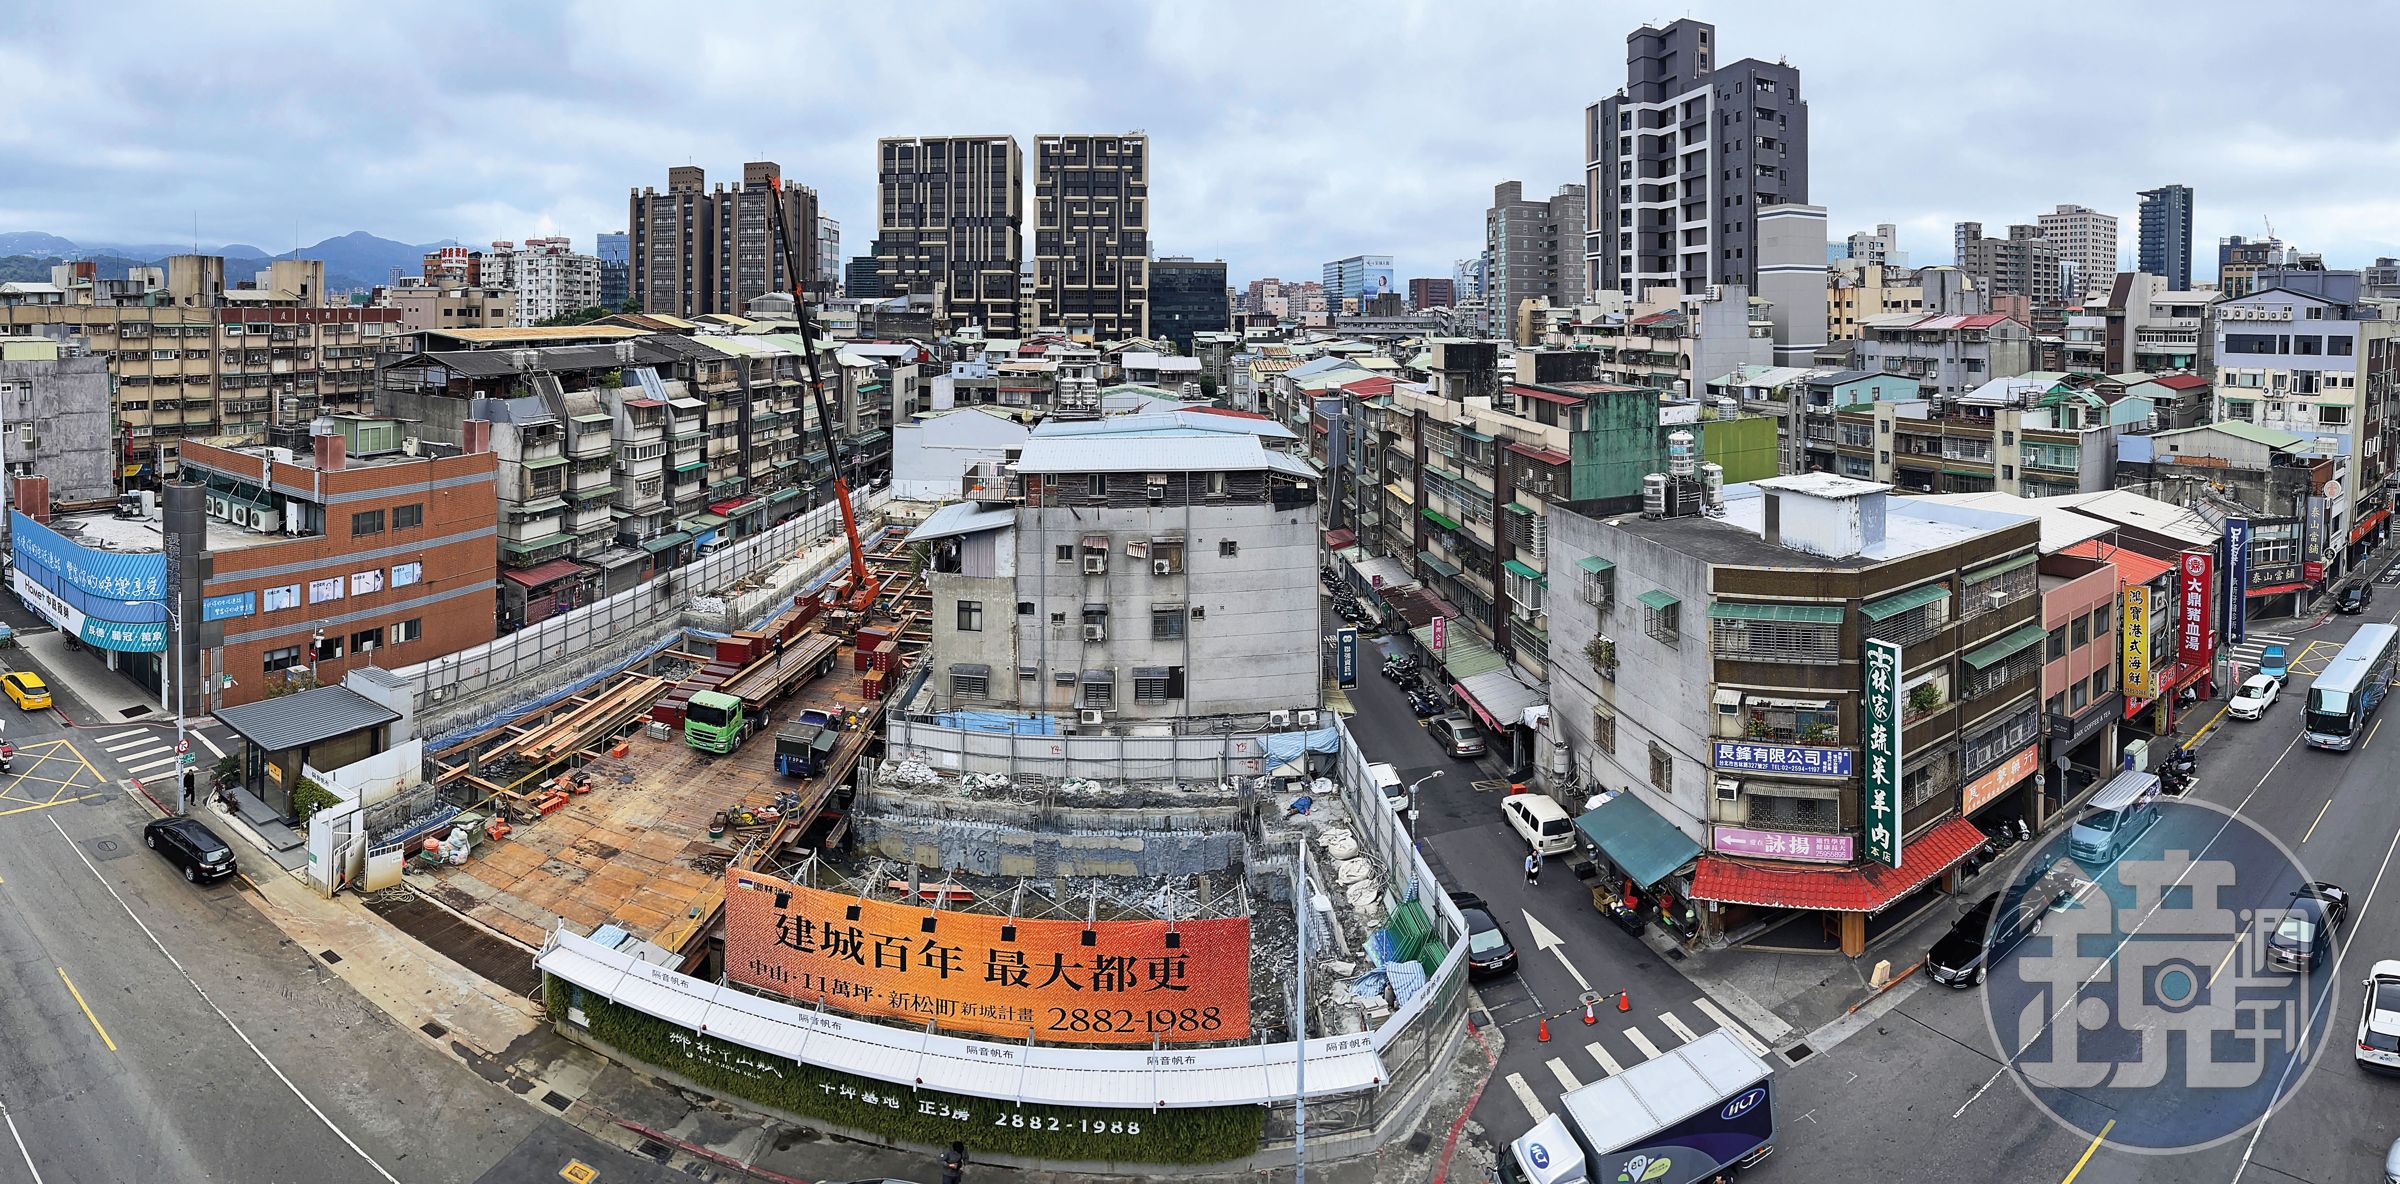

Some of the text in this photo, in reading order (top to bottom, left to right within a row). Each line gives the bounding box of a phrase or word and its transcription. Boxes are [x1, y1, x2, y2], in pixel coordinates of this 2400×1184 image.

[2187, 578, 2203, 651] 大鼎豬血湯
[2128, 589, 2144, 686] 鴻寶港式海鮮
[1719, 744, 1820, 766] 長鋒有限公司
[1870, 846, 1891, 862] 本店
[772, 911, 1192, 993] 建城百年 最大都更
[651, 969, 690, 988] 隔音帆布
[798, 1012, 842, 1031] 隔音帆布
[1047, 1005, 1223, 1034] 2882-1988
[965, 1045, 1015, 1060] 隔音帆布
[1325, 1035, 1373, 1053] 隔音帆布
[1146, 1055, 1196, 1066] 隔音帆布
[1728, 1092, 1756, 1118] HCT
[995, 1112, 1141, 1135] 2882-1988
[1531, 1144, 1548, 1165] HCT
